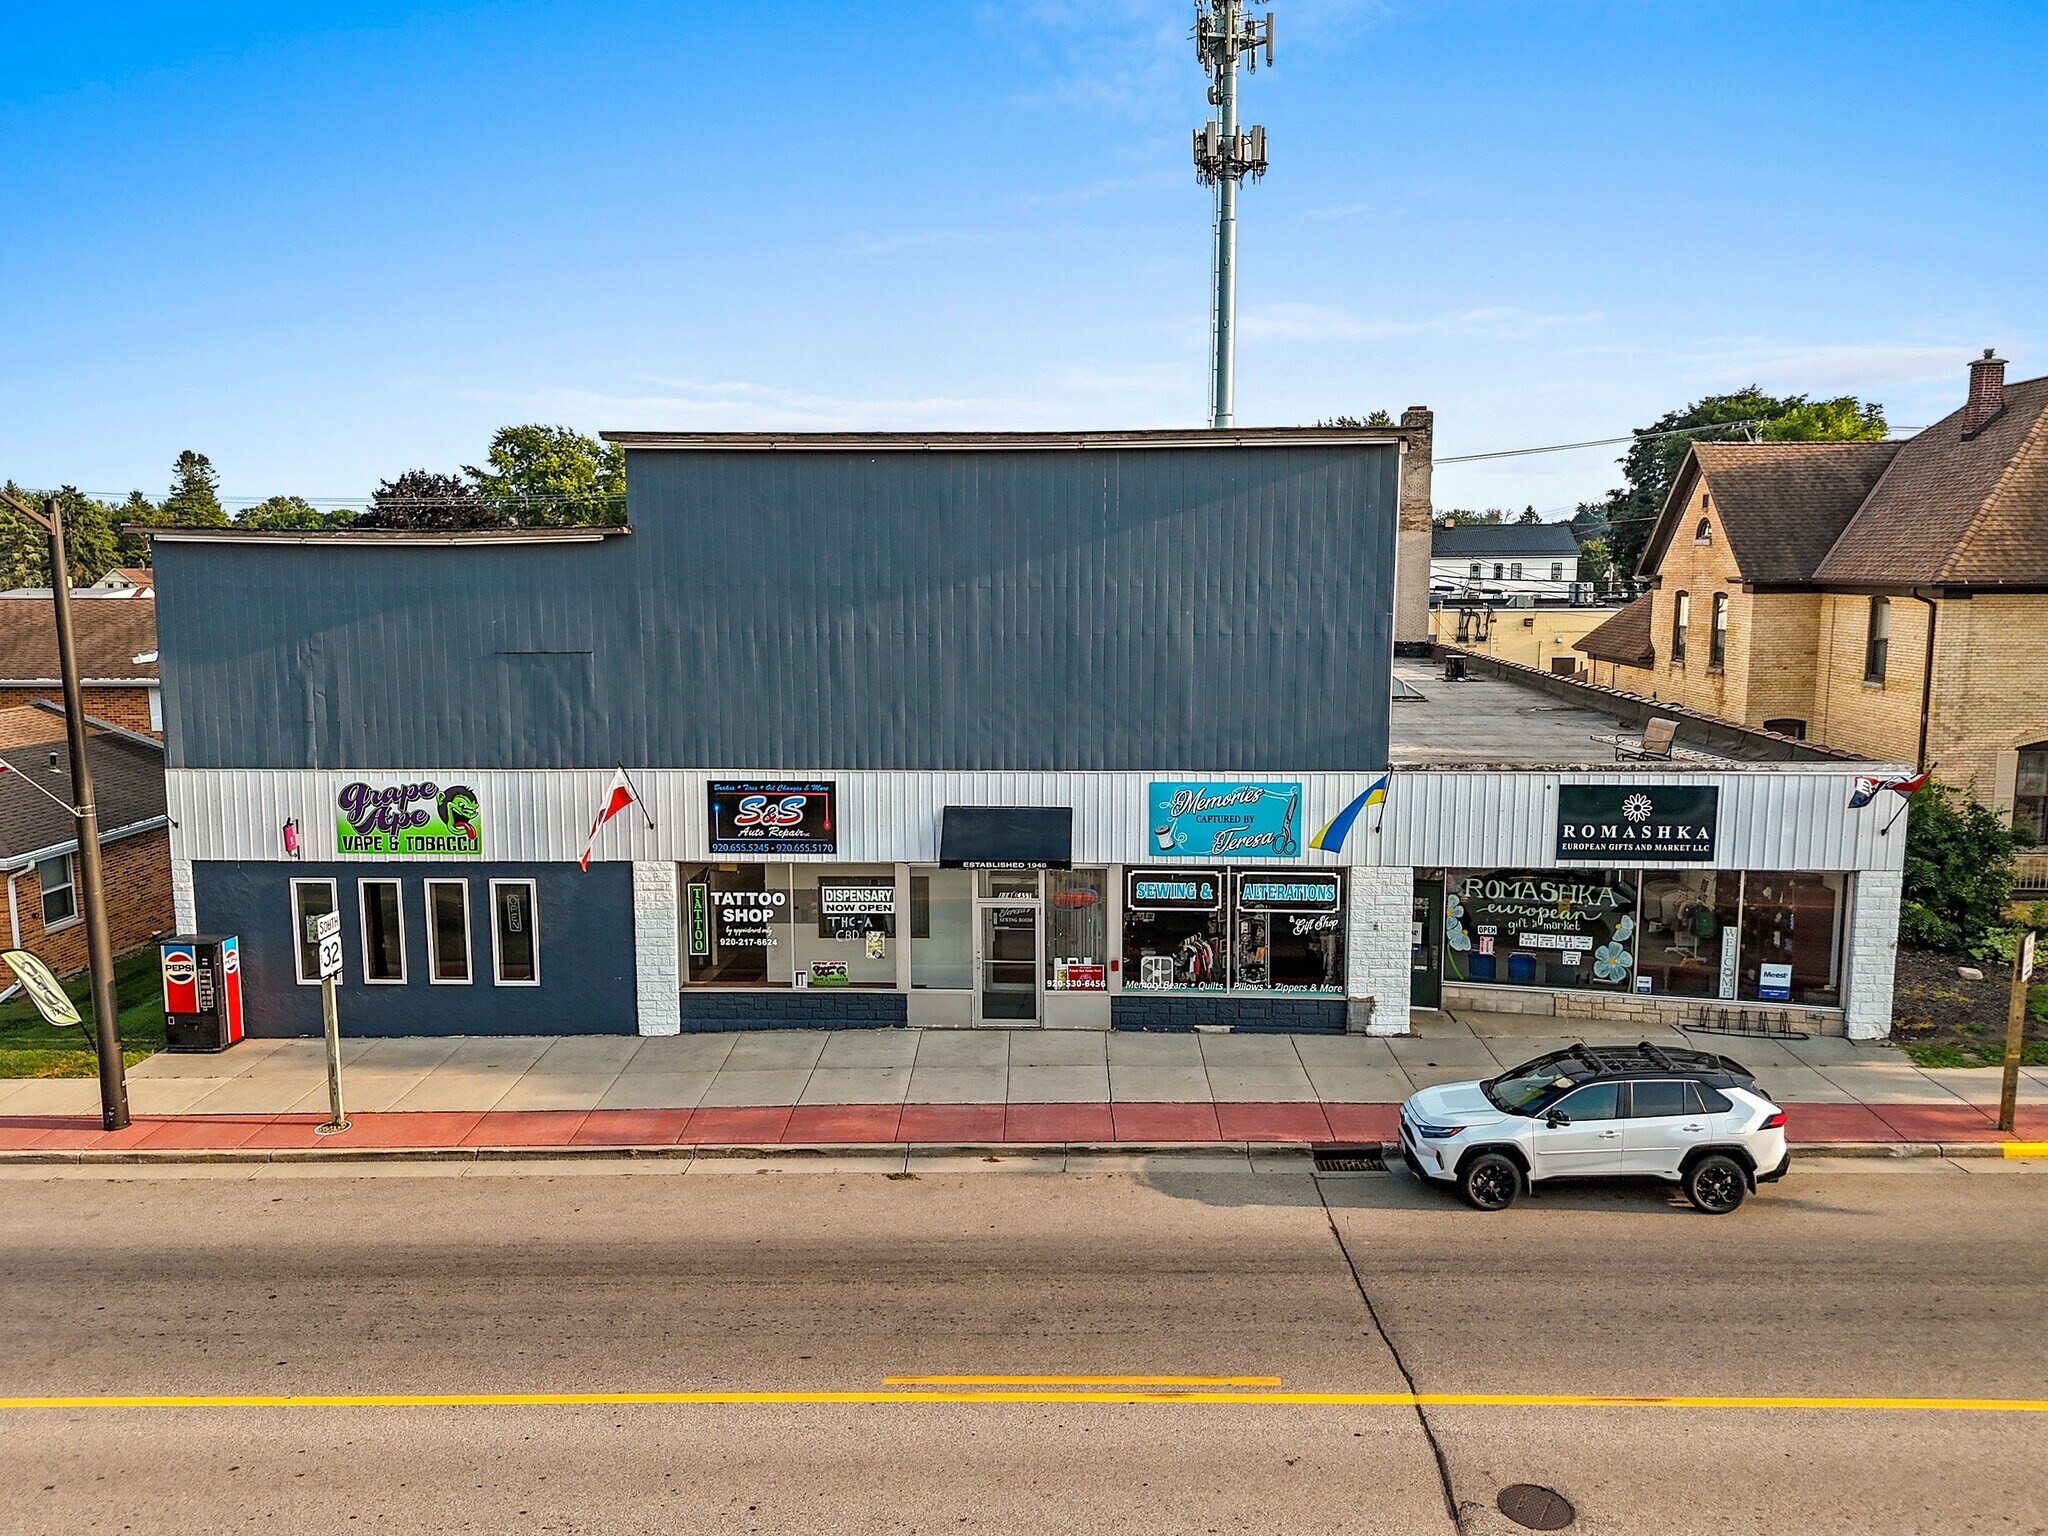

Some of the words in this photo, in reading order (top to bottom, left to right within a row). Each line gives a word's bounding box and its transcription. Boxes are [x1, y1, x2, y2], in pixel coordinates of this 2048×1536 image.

[777, 784, 802, 792] Changes
[1170, 785, 1265, 817] Memories
[734, 795, 807, 826] S&S
[351, 806, 431, 835] Ape
[1195, 815, 1241, 824] CAPTURED
[1243, 815, 1255, 824] BY
[738, 826, 764, 837] Auto
[769, 826, 804, 838] Repair
[1562, 824, 1710, 840] ROMASHKA
[342, 835, 382, 851] VAPE
[389, 835, 400, 851] &
[406, 835, 478, 851] TOBACCO
[712, 843, 770, 852] 920.655.5245
[776, 843, 834, 852] 920.655.5170
[1212, 825, 1274, 856] Teresa
[1608, 843, 1633, 851] GIFTS
[1654, 844, 1690, 852] MARKET
[825, 890, 893, 902] DISPENSARY
[1136, 882, 1197, 900] SEWING
[1200, 882, 1213, 900] &
[1242, 884, 1335, 902] ALTERATIONS
[1464, 878, 1618, 907] ROMASHKA
[710, 892, 786, 906] TATTOO
[1053, 892, 1094, 908] OPEN
[509, 896, 520, 929] OPEN
[826, 904, 856, 912] NOW
[858, 904, 892, 912] OPEN
[1476, 903, 1602, 924] european
[692, 888, 703, 951] TATTOO
[722, 909, 774, 922] SHOP
[826, 916, 873, 928] THC-A
[1289, 915, 1295, 923] &
[1292, 918, 1316, 936] Gift
[1314, 914, 1339, 931] Shop
[1507, 918, 1528, 935] gift
[1543, 920, 1581, 931] market
[719, 938, 778, 946] 920-217-6624
[835, 929, 860, 942] CBD
[323, 941, 340, 968] 32
[165, 964, 194, 972] PEPSI
[1763, 971, 1787, 979] Meest
[1047, 980, 1106, 988] 920-530-6456
[1125, 980, 1160, 991] Memory
[1163, 981, 1187, 991] Bears
[1198, 982, 1224, 991] Quilts
[1233, 982, 1264, 991] Pillows
[1274, 983, 1308, 993] Zippers
[1309, 984, 1317, 993] &
[1319, 984, 1343, 993] More
